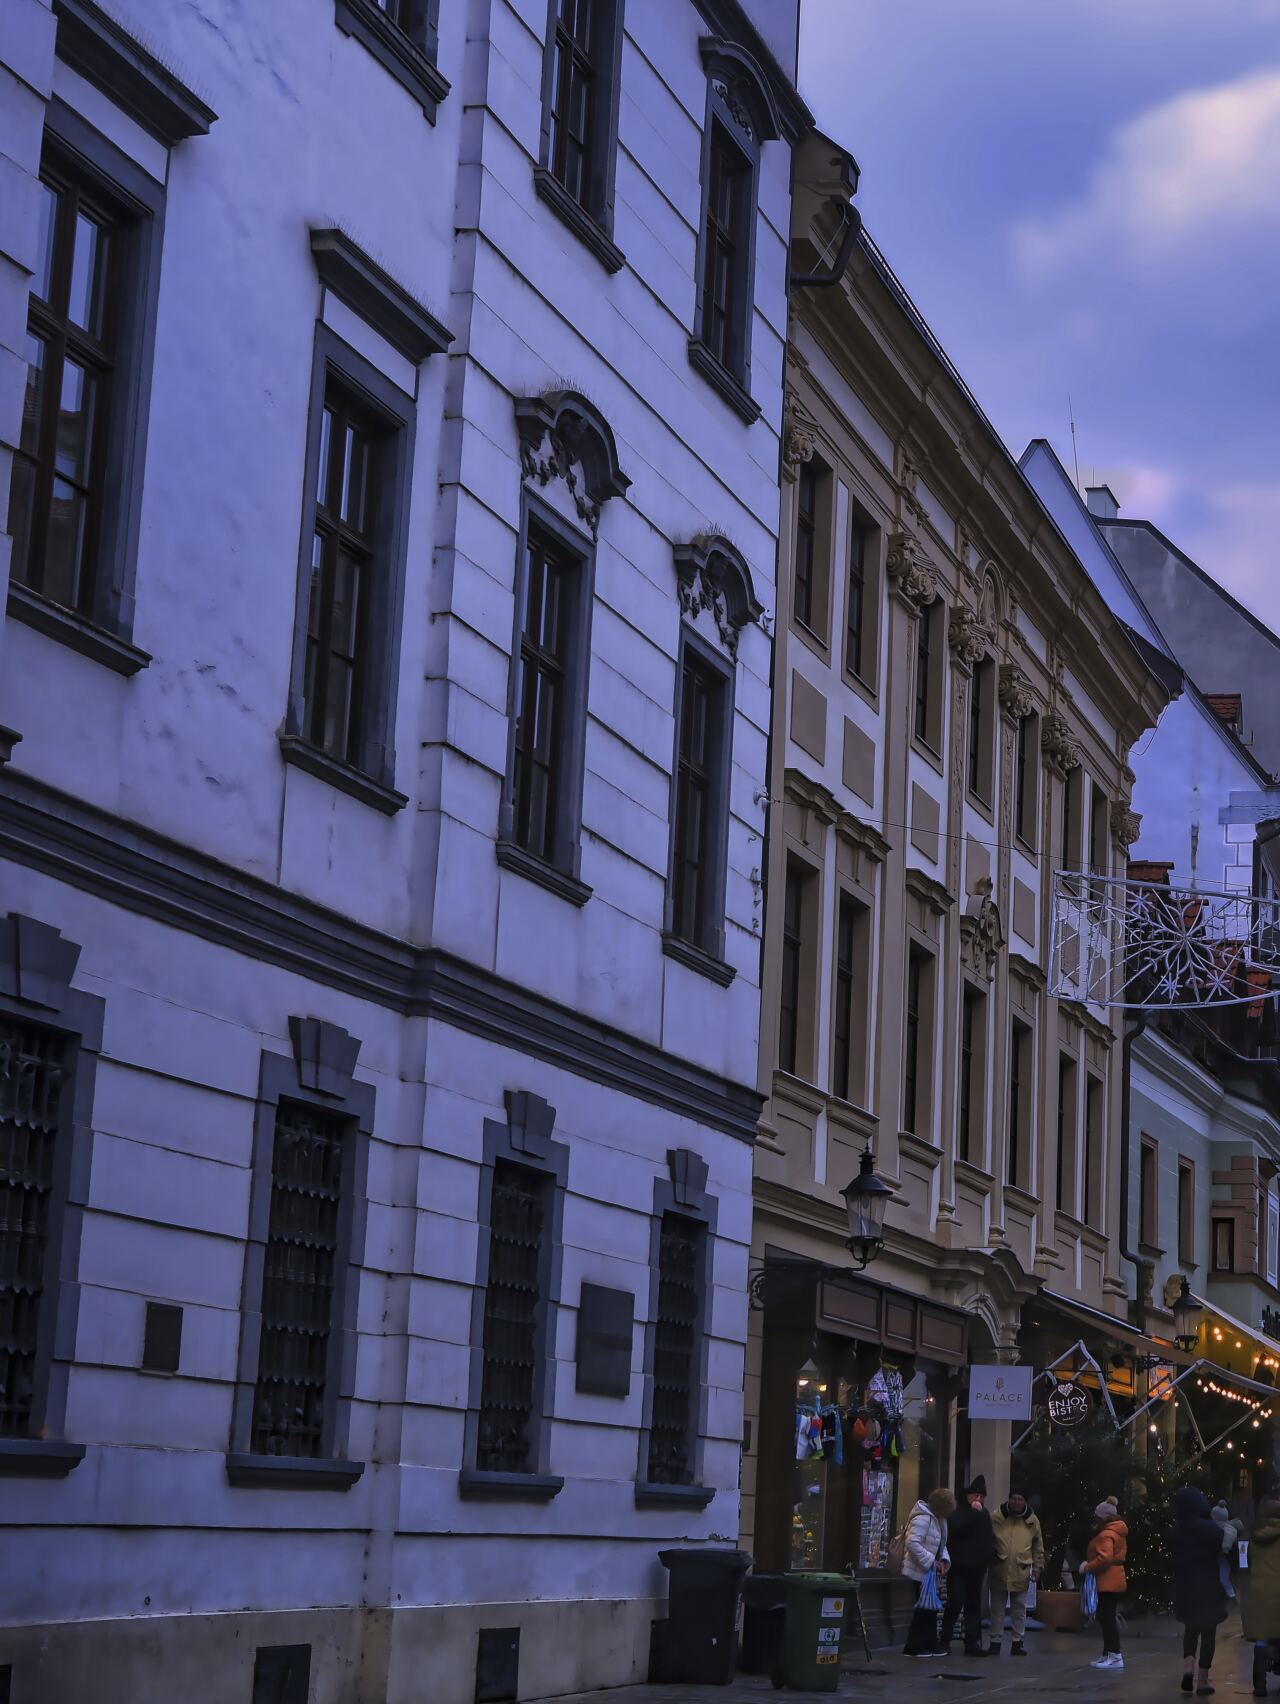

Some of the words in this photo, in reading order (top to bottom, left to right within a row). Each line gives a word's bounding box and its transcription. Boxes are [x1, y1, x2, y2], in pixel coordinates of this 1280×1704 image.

[976, 1392, 1023, 1402] PALACE
[1048, 1395, 1087, 1410] ENJOY
[1049, 1404, 1088, 1417] BISTO
